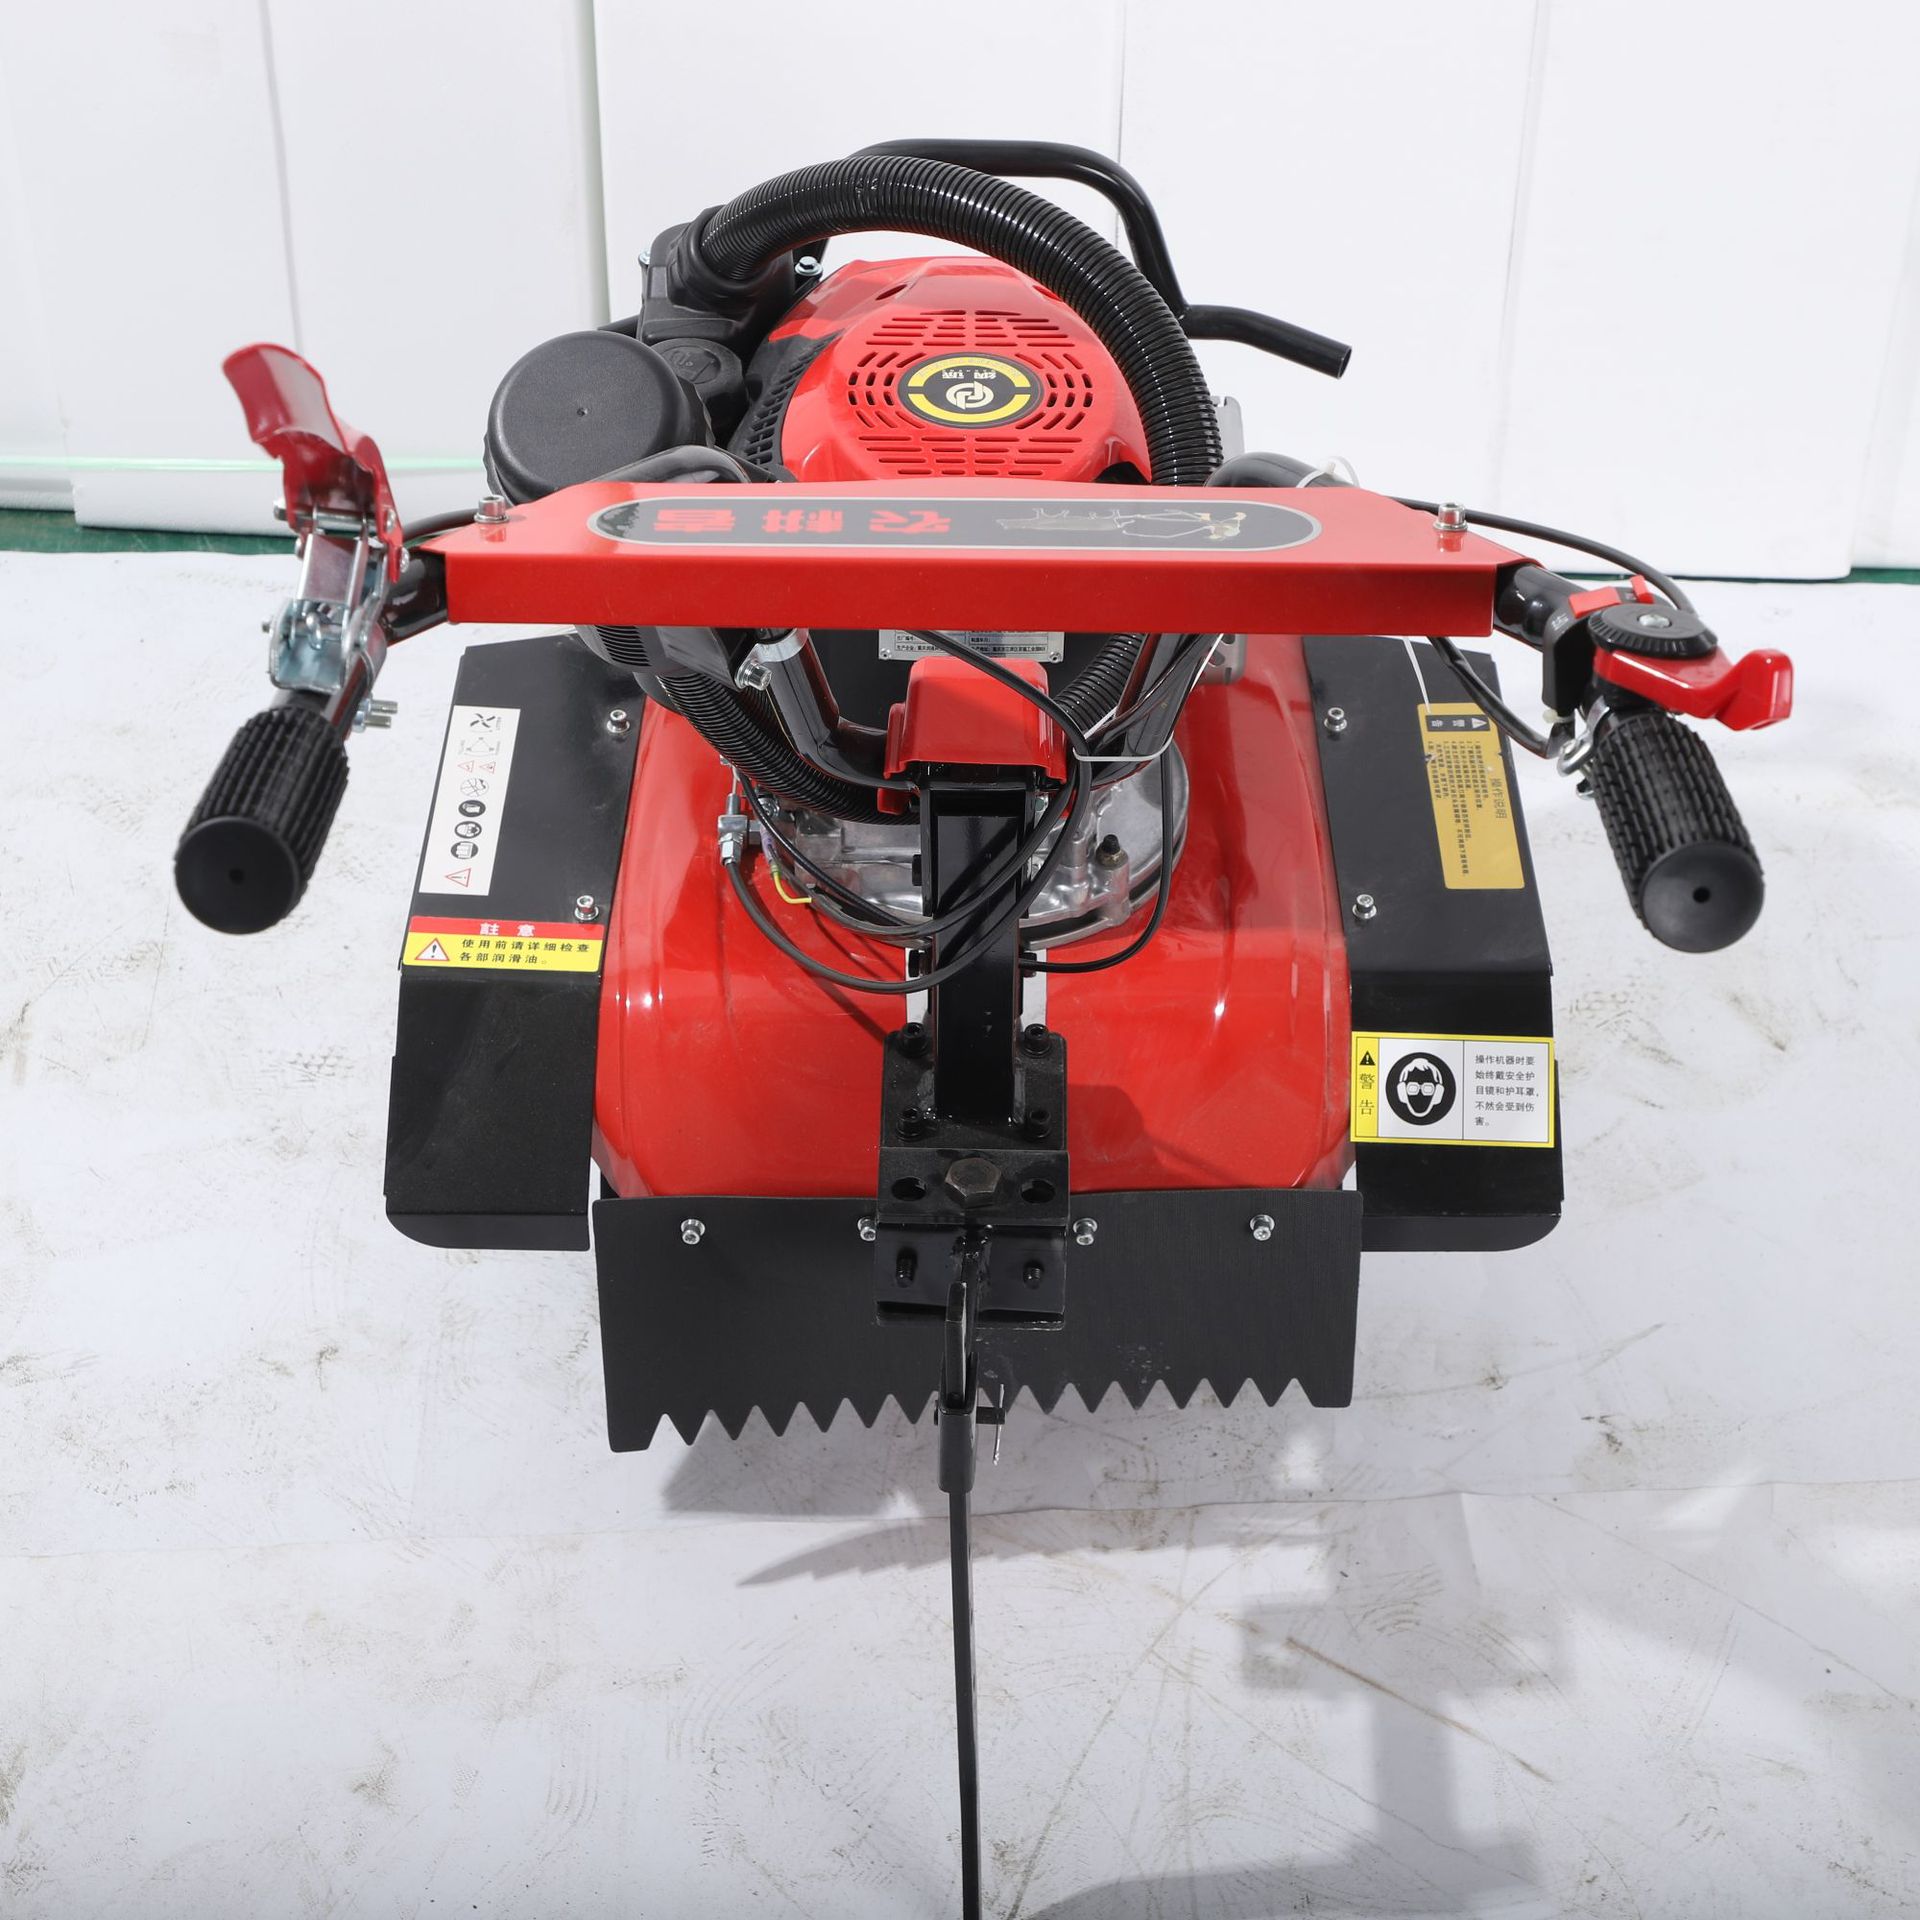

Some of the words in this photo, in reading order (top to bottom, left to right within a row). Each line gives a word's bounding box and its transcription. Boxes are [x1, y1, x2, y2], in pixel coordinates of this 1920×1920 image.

[462, 938, 591, 953] 使用前请详细检查
[1474, 1054, 1536, 1066] 操作机器时要
[1474, 1070, 1536, 1081] 始终戴安全护
[1359, 1072, 1375, 1116] 警告
[1474, 1100, 1535, 1112] 不然会受到伤
